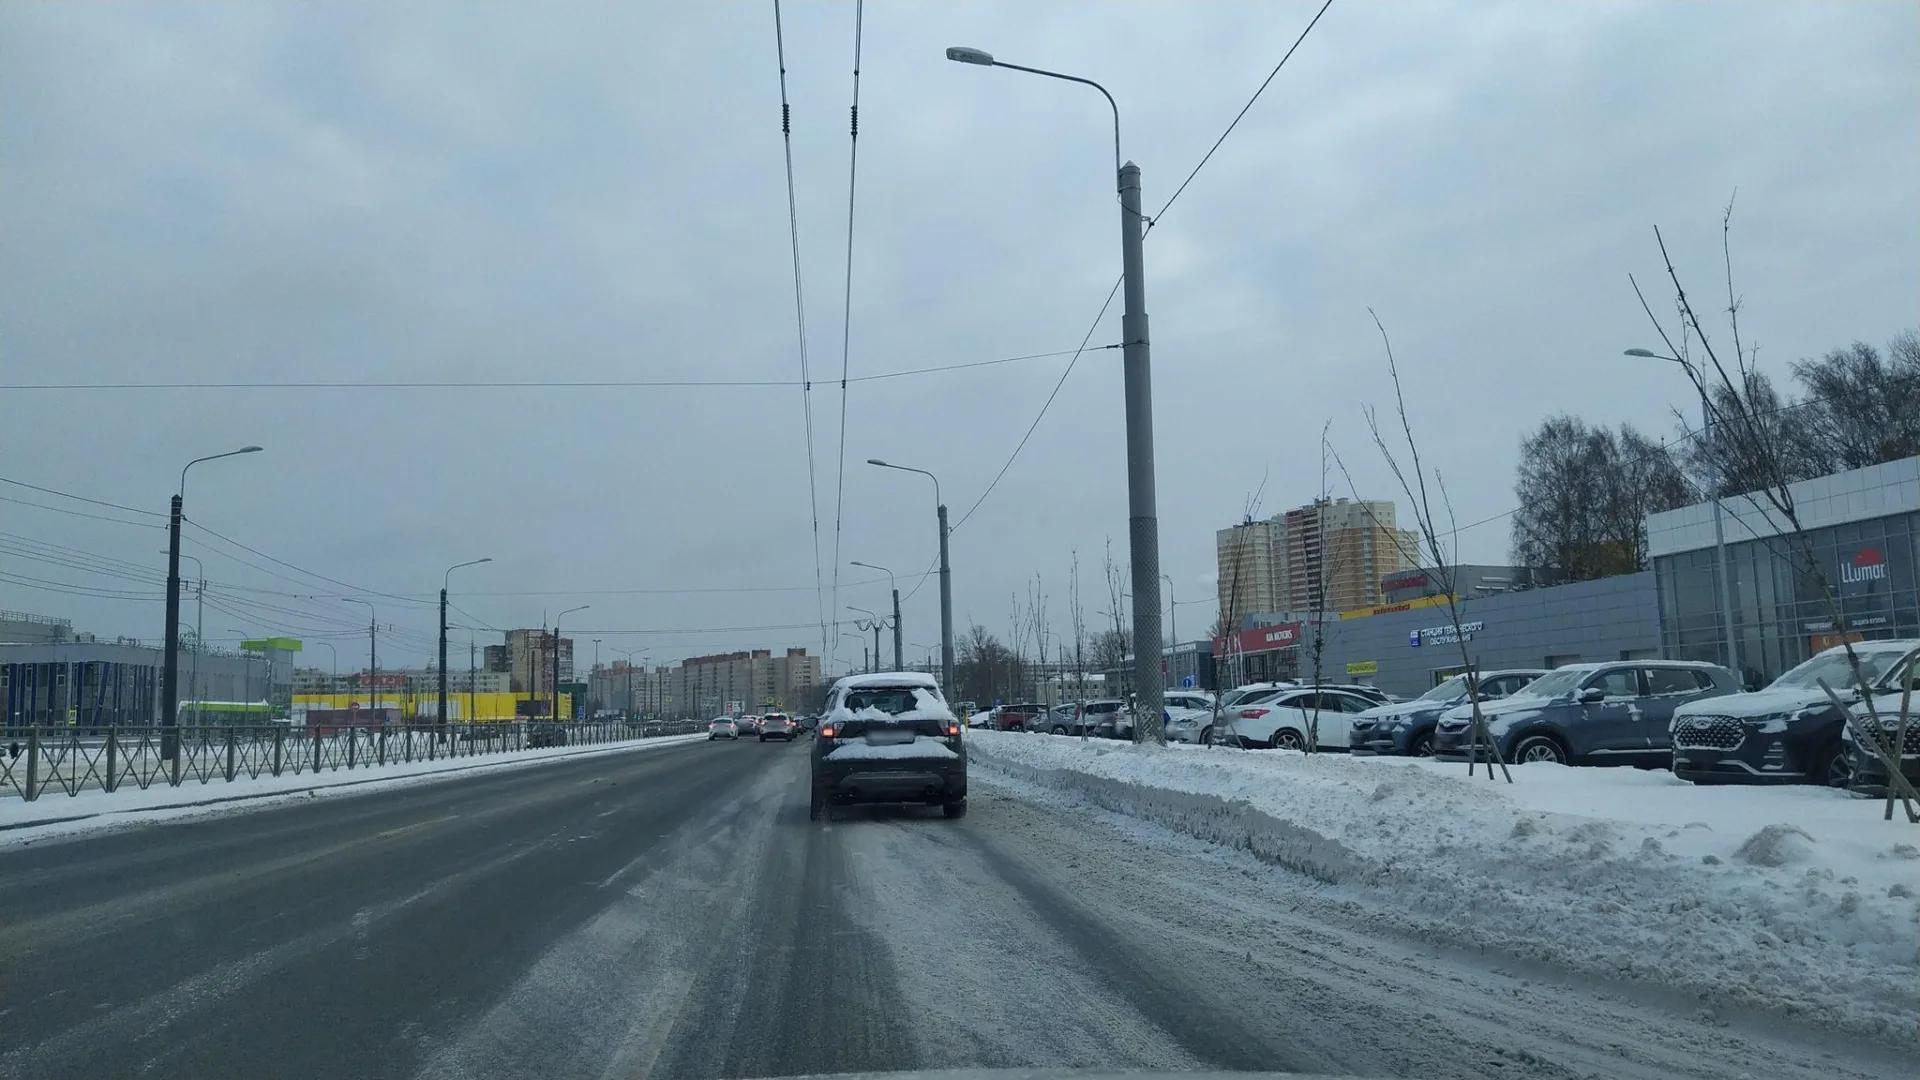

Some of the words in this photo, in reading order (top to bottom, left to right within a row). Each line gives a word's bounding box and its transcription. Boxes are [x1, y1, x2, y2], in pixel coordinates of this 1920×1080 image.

[1842, 562, 1885, 583] LLumar
[1420, 627, 1443, 637] СТАНЦИЯ
[1444, 622, 1483, 635] ТЕХНЧЕСКОГО
[1430, 634, 1471, 645] ОБСЛУЖИВАИЯ
